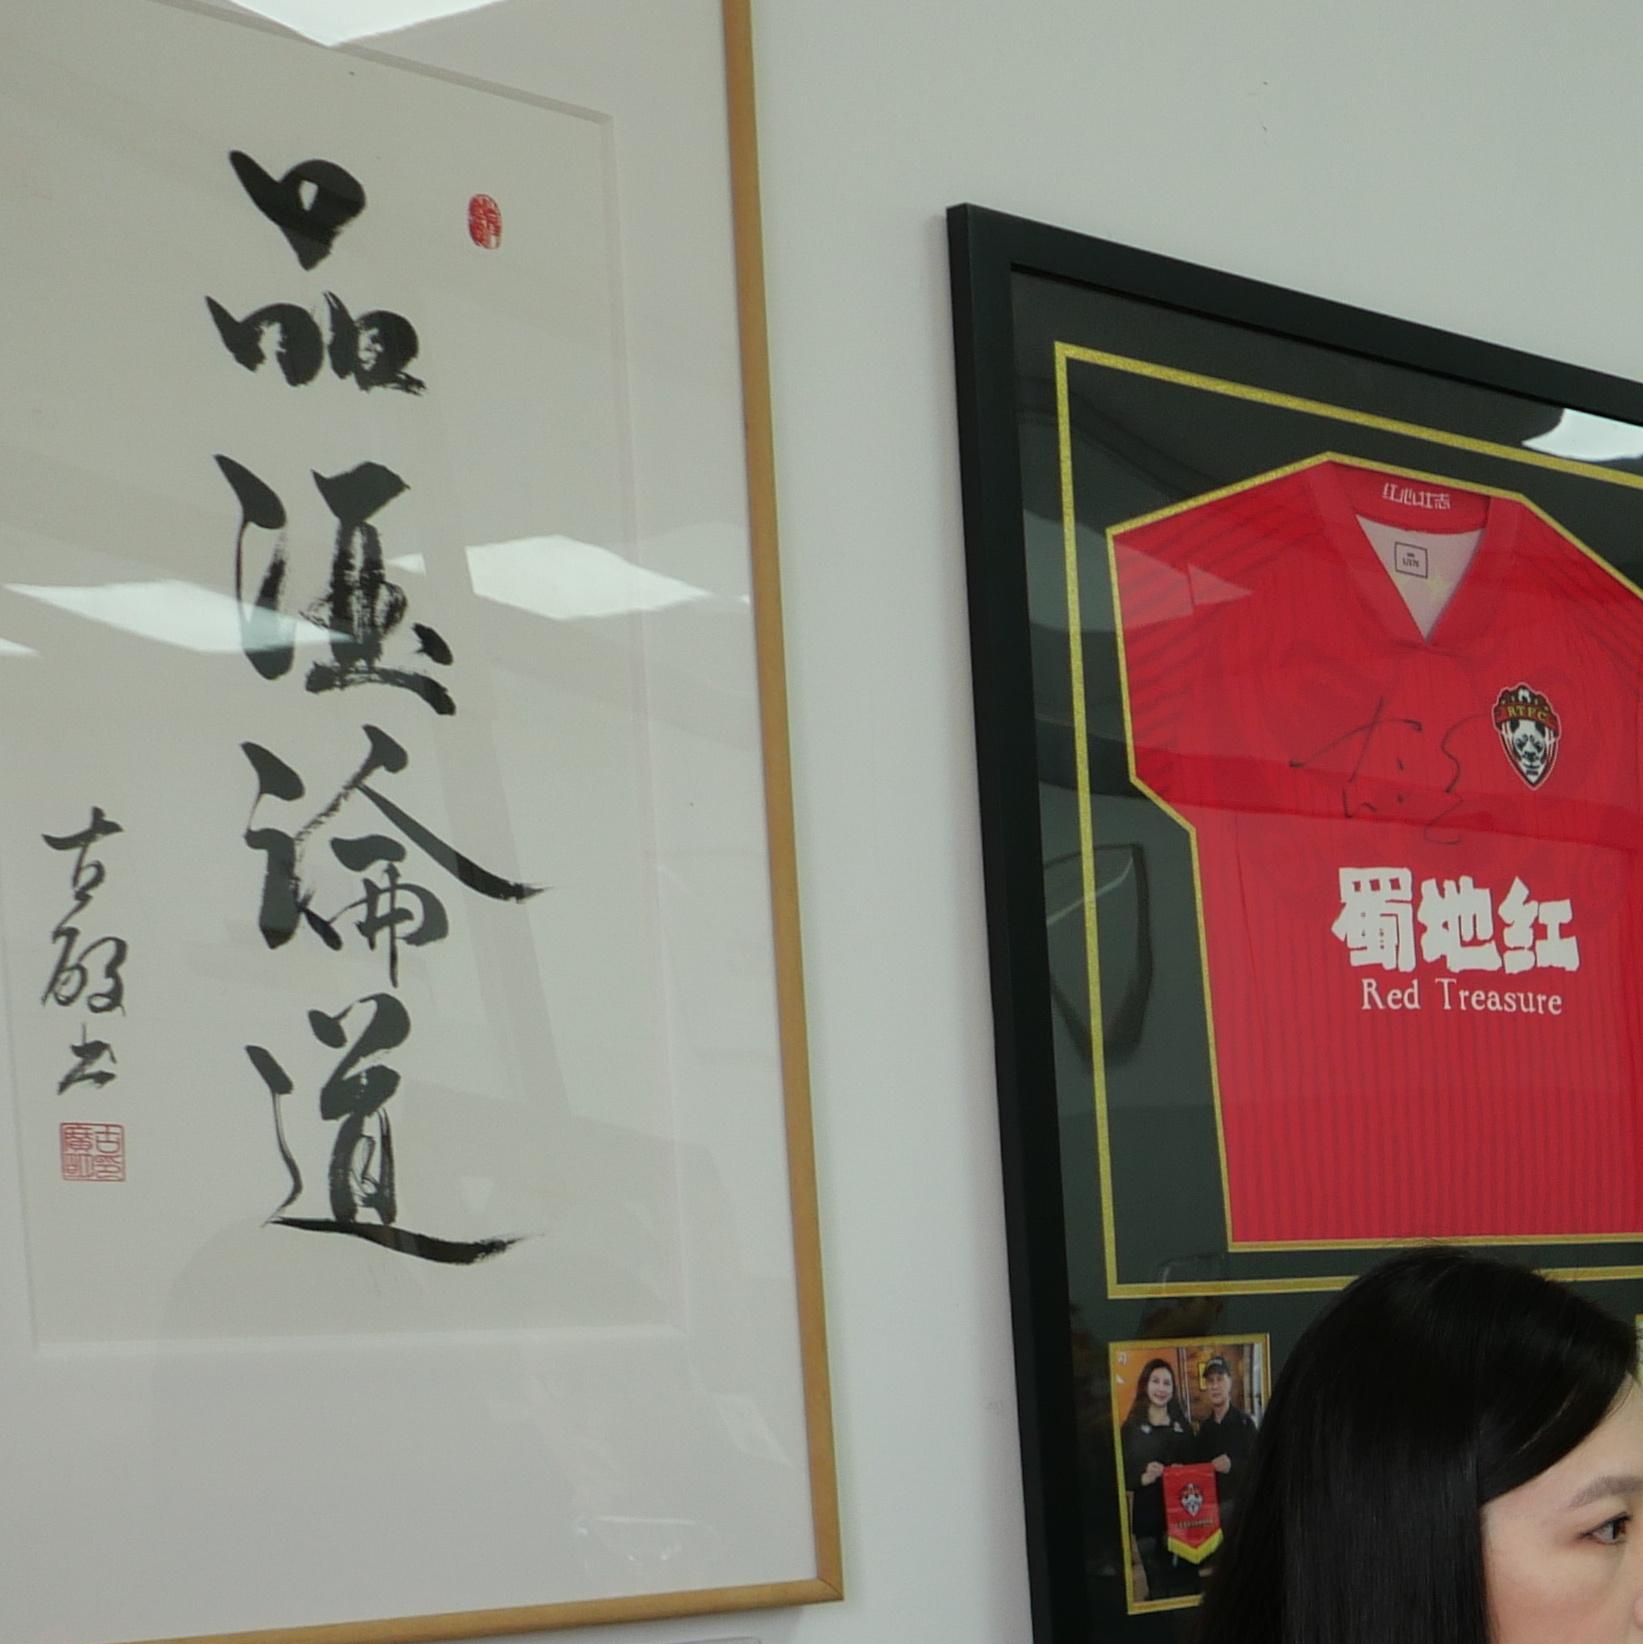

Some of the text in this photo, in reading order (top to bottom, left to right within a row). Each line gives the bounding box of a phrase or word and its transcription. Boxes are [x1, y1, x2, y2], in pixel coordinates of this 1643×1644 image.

[1331, 867, 1581, 974] 蜀地红
[1361, 978, 1563, 1016] Red Treasure
